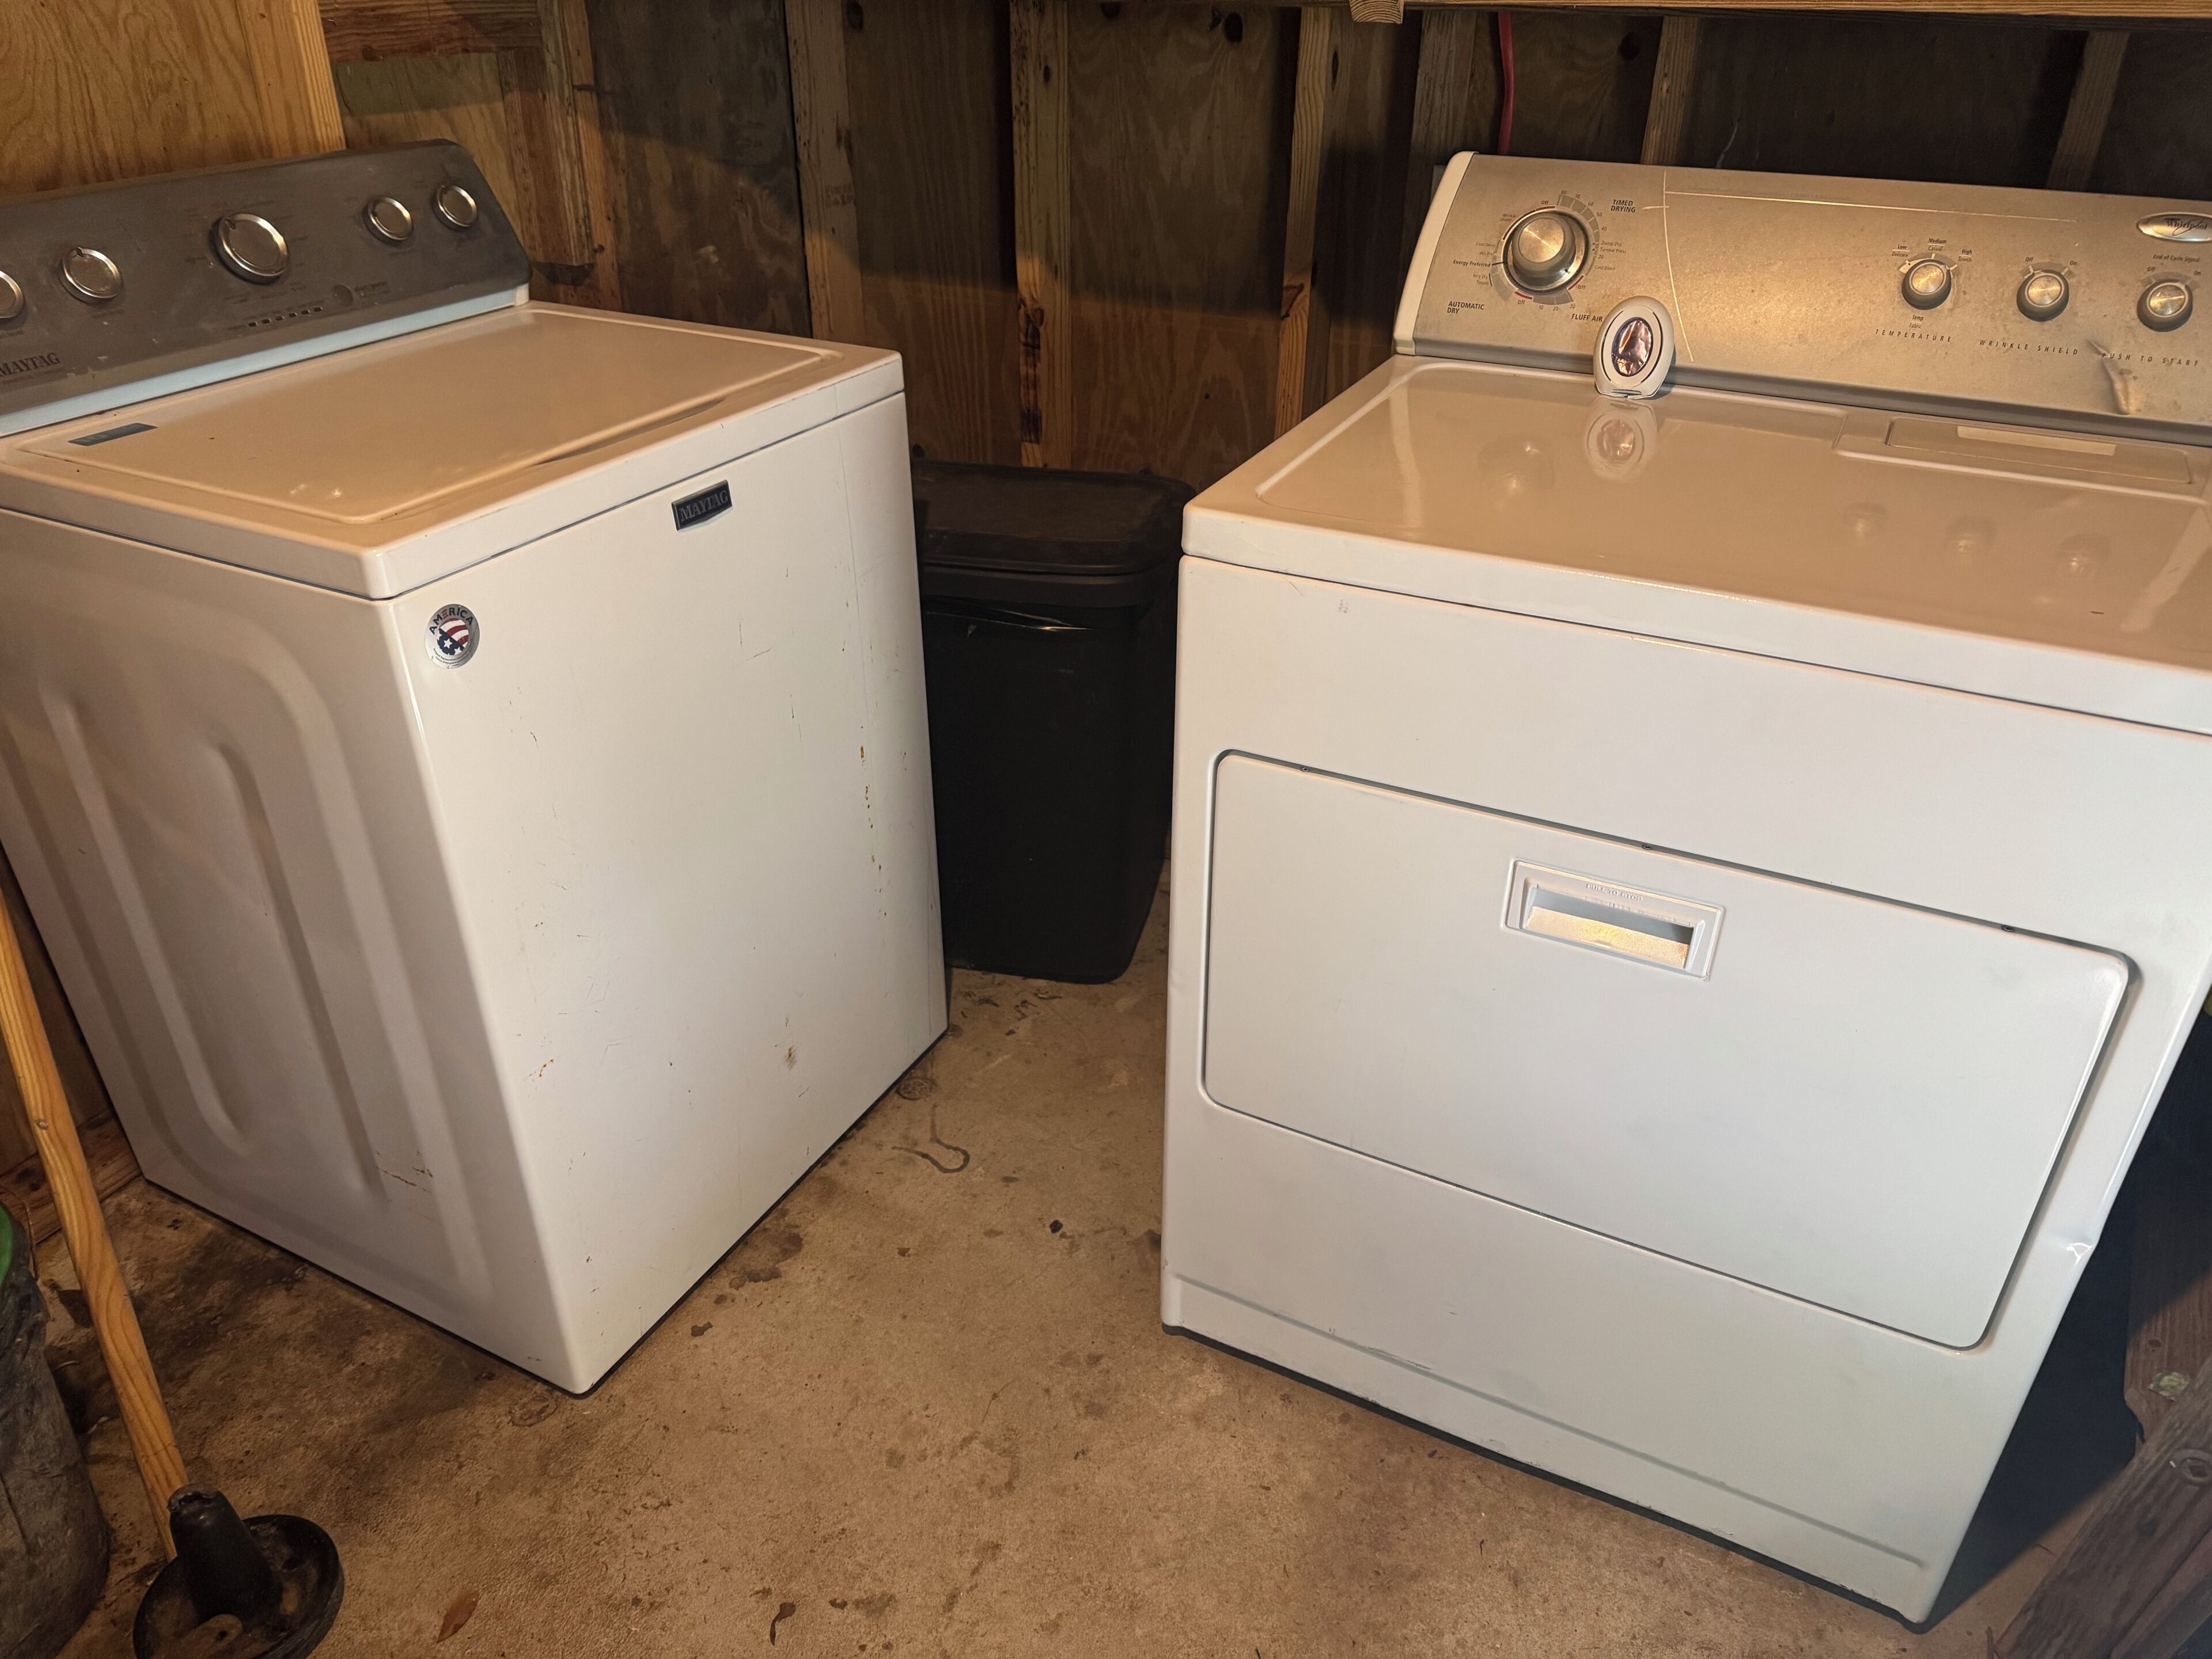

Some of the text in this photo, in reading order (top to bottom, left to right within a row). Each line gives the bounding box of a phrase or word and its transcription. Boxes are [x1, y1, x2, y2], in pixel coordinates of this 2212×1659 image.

[1448, 301, 1484, 310] AUTOMATIC
[1876, 329, 1952, 342] TEMPERATURE
[1979, 339, 2078, 355] WRINKLE SHIELD
[0, 353, 60, 377] MAYTAG
[2102, 353, 2131, 361] PUSH
[2162, 358, 2199, 366] START
[678, 490, 729, 522] MAYTAG
[429, 607, 474, 635] AMERICA
